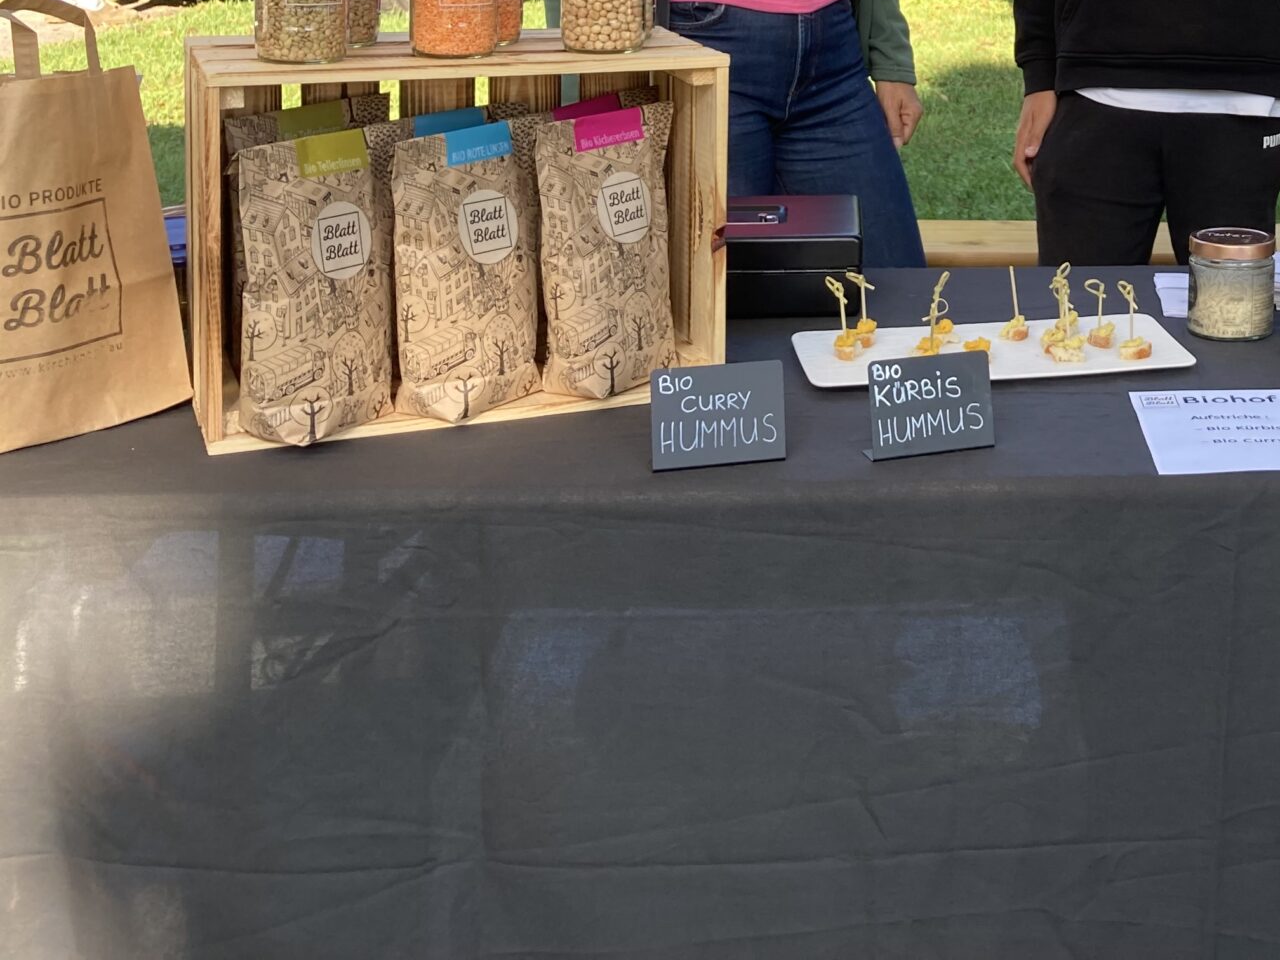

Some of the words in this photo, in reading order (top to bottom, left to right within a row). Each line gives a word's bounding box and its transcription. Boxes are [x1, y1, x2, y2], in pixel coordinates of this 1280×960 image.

[0, 194, 21, 210] IO
[29, 178, 103, 206] PRODUKTE
[609, 188, 642, 207] Blatt
[470, 205, 505, 224] Blatt
[614, 206, 645, 225] Blatt
[323, 221, 357, 241] Blatt
[474, 225, 507, 244] Blatt
[2, 222, 104, 277] Blatt
[325, 241, 359, 261] Blatt
[3, 273, 110, 331] Blatt
[873, 364, 901, 381] BIO
[658, 375, 693, 394] BIO
[681, 391, 751, 413] CURRY
[1182, 394, 1277, 404] Biohof
[660, 413, 777, 454] HUMMUS
[878, 403, 984, 447] HUMMUS
